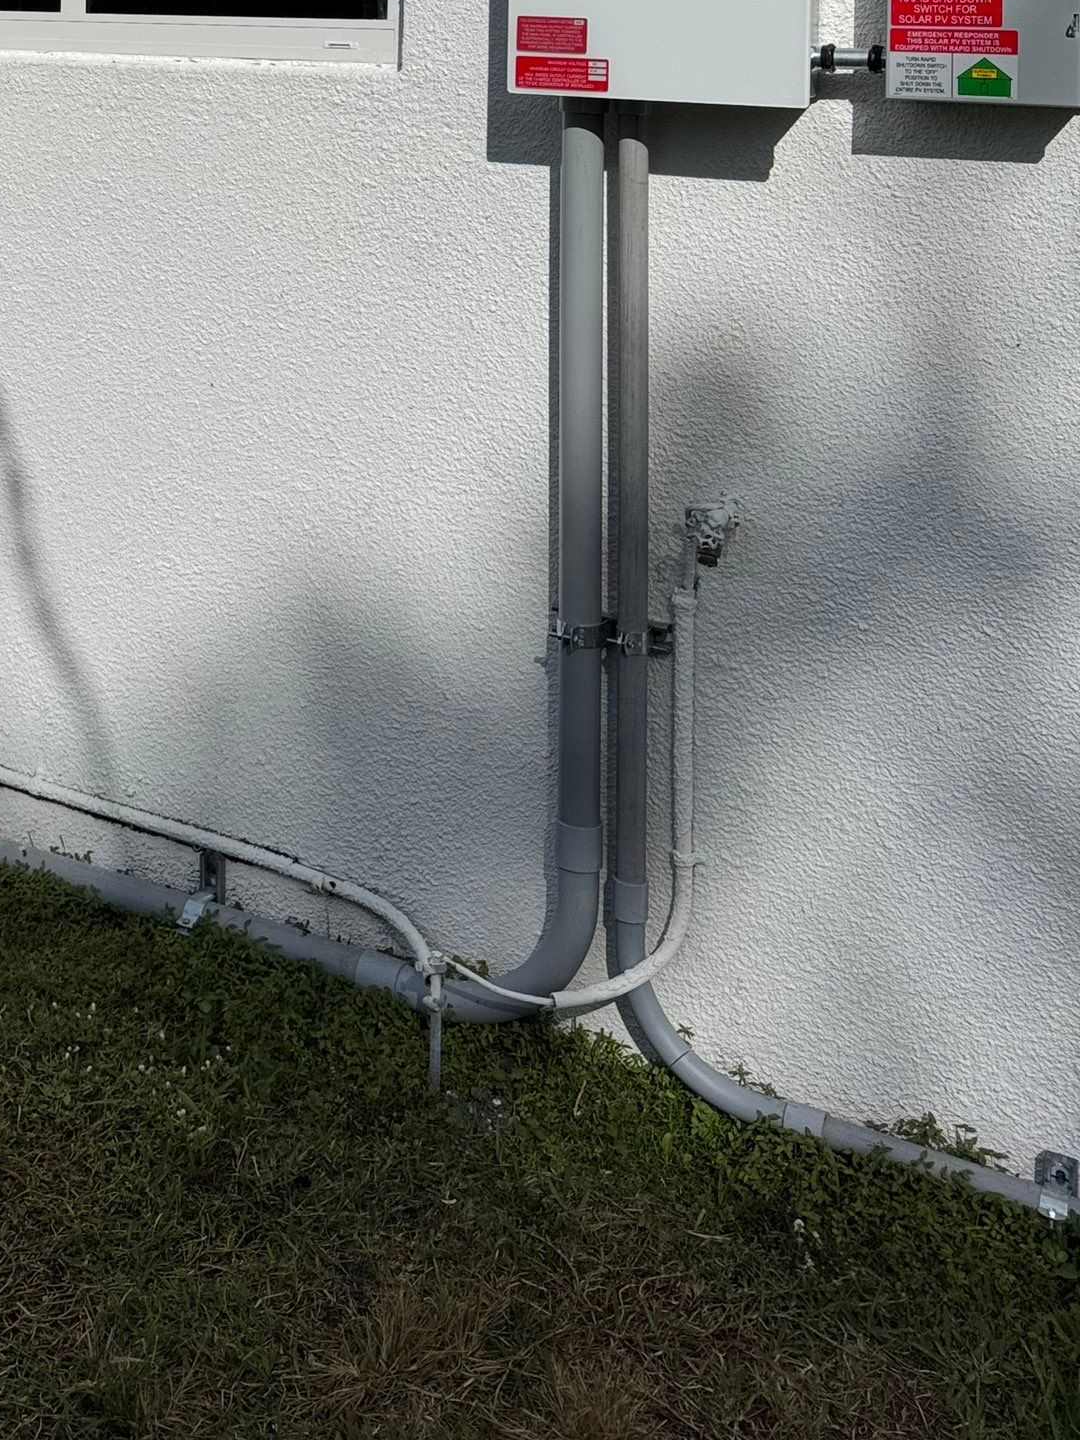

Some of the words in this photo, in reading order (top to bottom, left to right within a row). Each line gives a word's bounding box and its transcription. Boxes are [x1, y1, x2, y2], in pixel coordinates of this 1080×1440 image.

[914, 4, 953, 14] SWITCH
[956, 5, 977, 14] FOR
[898, 15, 932, 24] SOLAR
[934, 16, 948, 24] PV
[951, 16, 992, 24] SYSTEM
